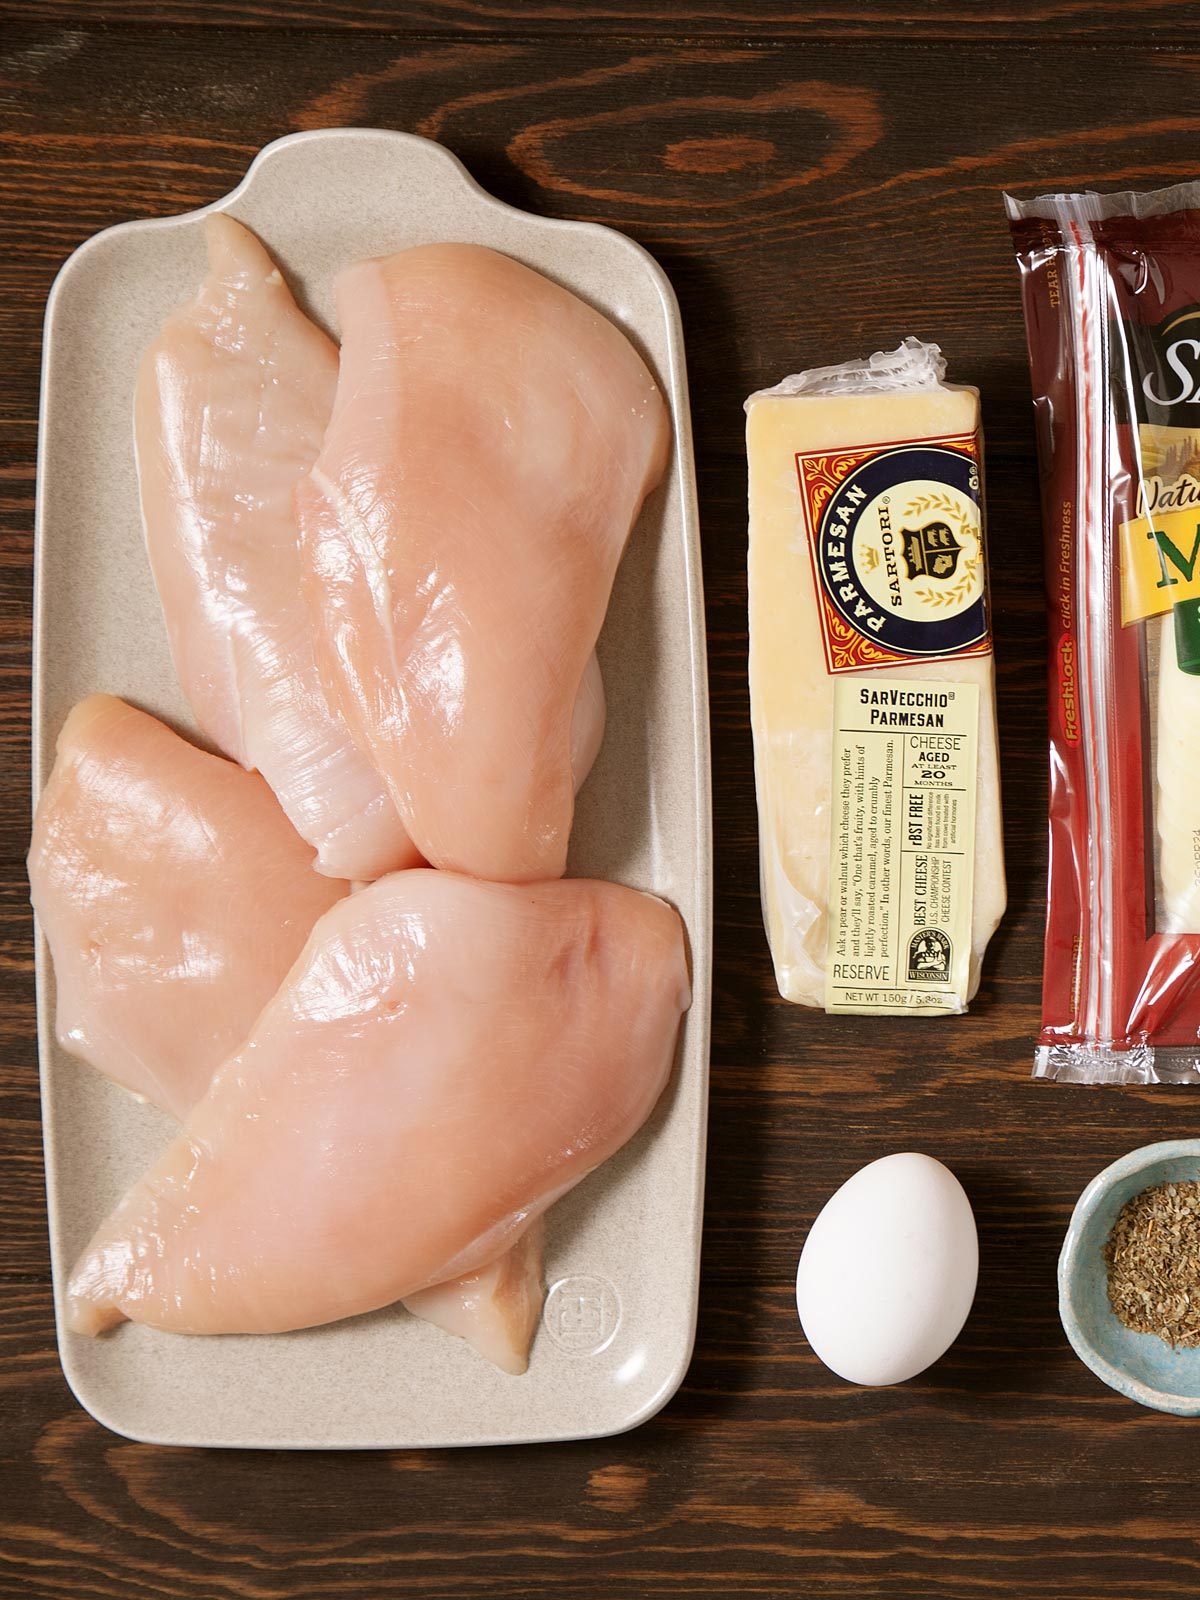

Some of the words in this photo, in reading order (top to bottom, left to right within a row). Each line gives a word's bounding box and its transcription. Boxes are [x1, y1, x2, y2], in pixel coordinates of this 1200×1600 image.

[1047, 269, 1060, 308] TEAR
[1059, 501, 1071, 574] Freshness
[827, 483, 887, 633] PARMESAN
[1061, 576, 1071, 591] in
[870, 709, 944, 727] PARMESAN
[855, 745, 865, 754] of
[910, 736, 960, 750] CHEESE
[841, 749, 852, 776] prefer
[855, 757, 865, 780] hints
[883, 740, 894, 787] Parmesan.
[919, 752, 950, 762] AGED
[921, 770, 946, 779] 20
[841, 779, 851, 798] they
[855, 783, 864, 802] with
[869, 777, 879, 814] crumbly
[883, 791, 892, 816] finest
[909, 794, 923, 818] FREE
[840, 801, 850, 830] cheese
[854, 805, 865, 834] fruity,
[869, 817, 877, 825] to
[884, 819, 892, 833] our
[868, 828, 878, 848] aged
[909, 822, 922, 845] rBST
[839, 833, 849, 859] which
[882, 836, 892, 865] words,
[838, 862, 848, 893] walnut
[881, 868, 890, 891] other
[915, 855, 927, 895] CHEESE
[930, 857, 939, 908] CHAMPIONSHIP
[942, 860, 951, 893] CONTEST
[841, 896, 847, 905] or
[866, 892, 875, 925] roasted
[880, 894, 889, 903] In
[941, 895, 950, 922] CHEESE
[840, 908, 849, 928] pear
[914, 899, 926, 925] BEST
[929, 911, 938, 924] U.S.
[837, 939, 846, 956] Ask
[851, 940, 860, 956] and
[864, 928, 875, 956] lightly
[833, 964, 890, 980] RESERVE
[910, 971, 948, 980] WISCONSIN
[845, 992, 863, 1002] NET
[865, 993, 879, 1002] WT
[883, 993, 907, 1004] 150g
